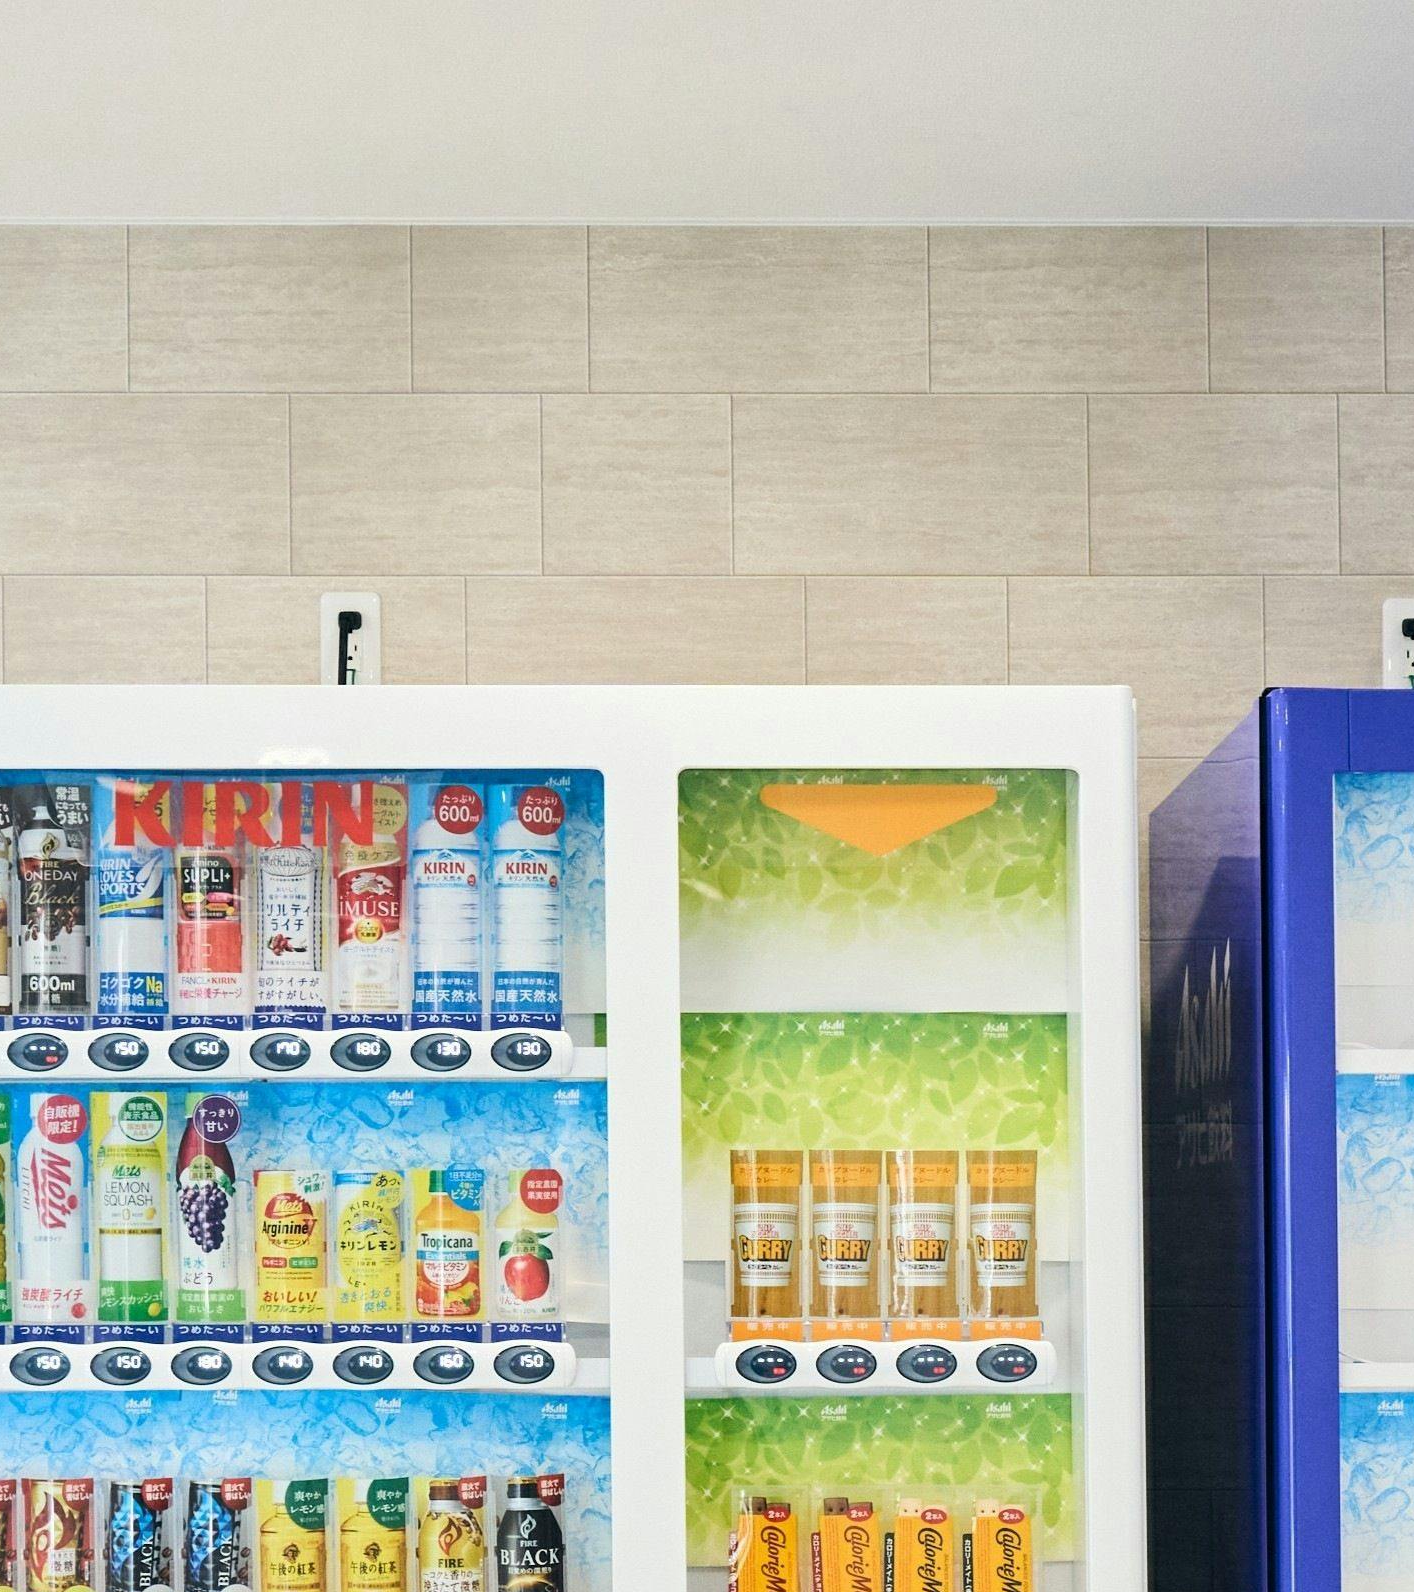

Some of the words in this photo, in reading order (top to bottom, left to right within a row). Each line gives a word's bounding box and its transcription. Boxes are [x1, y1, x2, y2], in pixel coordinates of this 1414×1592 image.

[442, 795, 475, 803] たっぷり
[526, 795, 558, 804] たっぷり
[115, 781, 373, 846] KIRIN
[41, 860, 59, 868] FIRE
[424, 862, 465, 875] KIRIN
[506, 863, 547, 875] KIRIN
[25, 871, 77, 881] ONEDAY
[272, 918, 304, 931] ライチ
[146, 979, 162, 992] Na
[437, 1042, 460, 1055] 130
[198, 1107, 235, 1118] すっきり
[206, 1121, 228, 1131] 甘い
[105, 1183, 150, 1193] LEMON
[104, 1195, 153, 1206] SQUASH
[421, 1234, 473, 1250] Tropicana
[140, 1536, 152, 1587] BLACK
[219, 1536, 231, 1587] BLACK
[438, 1559, 464, 1567] FIRE
[500, 1550, 559, 1566] BLACK
[270, 1563, 316, 1575] 午後の紅茶
[350, 1563, 397, 1575] 午後の紅茶
